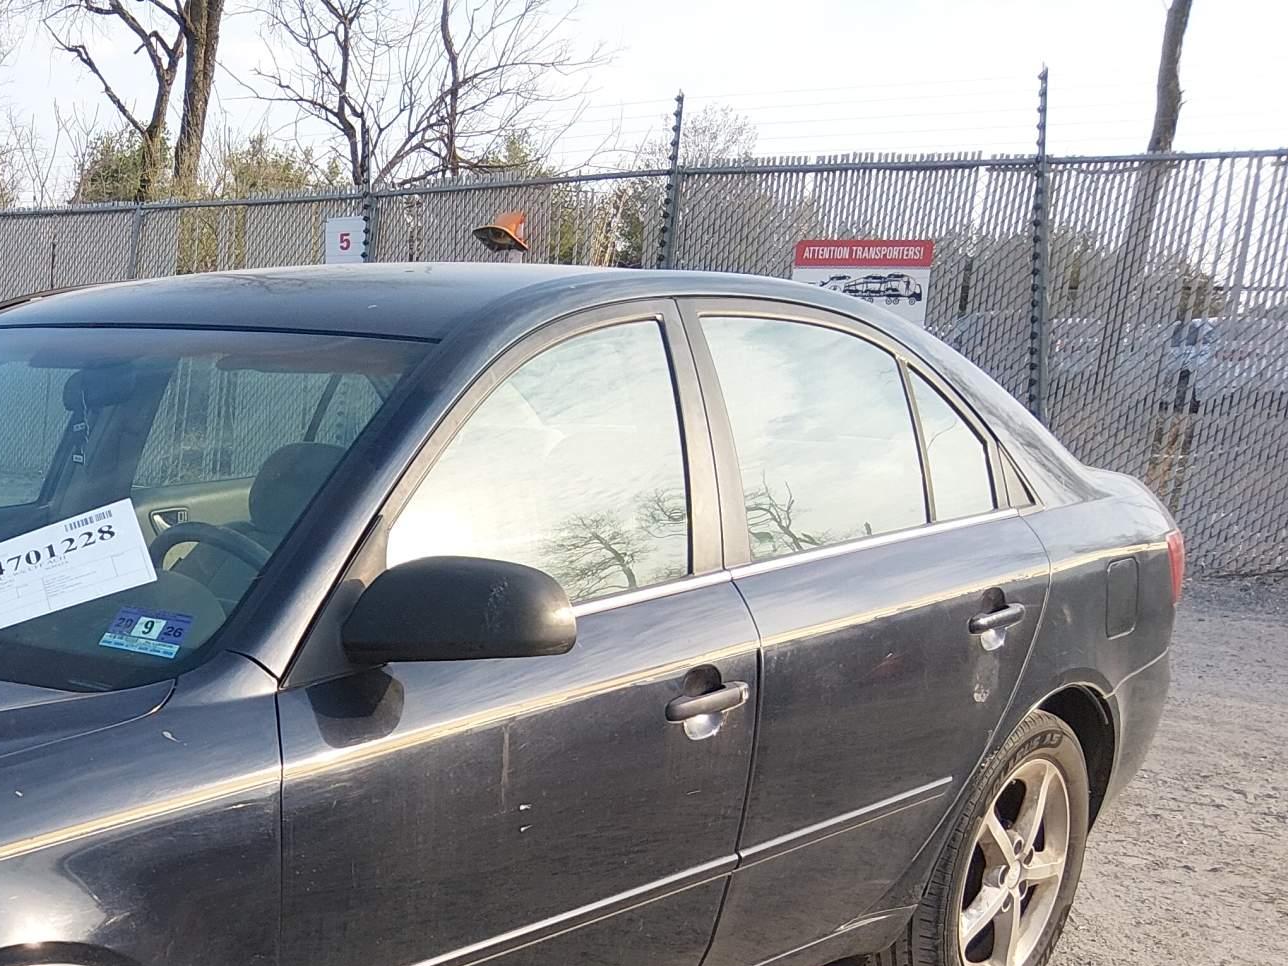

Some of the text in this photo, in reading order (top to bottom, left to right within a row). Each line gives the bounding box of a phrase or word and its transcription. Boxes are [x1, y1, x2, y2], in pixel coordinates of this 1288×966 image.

[339, 232, 351, 251] 5
[803, 246, 925, 260] ATTENTION TRANSPORTERS!
[142, 620, 155, 635] 9
[163, 626, 184, 638] 26
